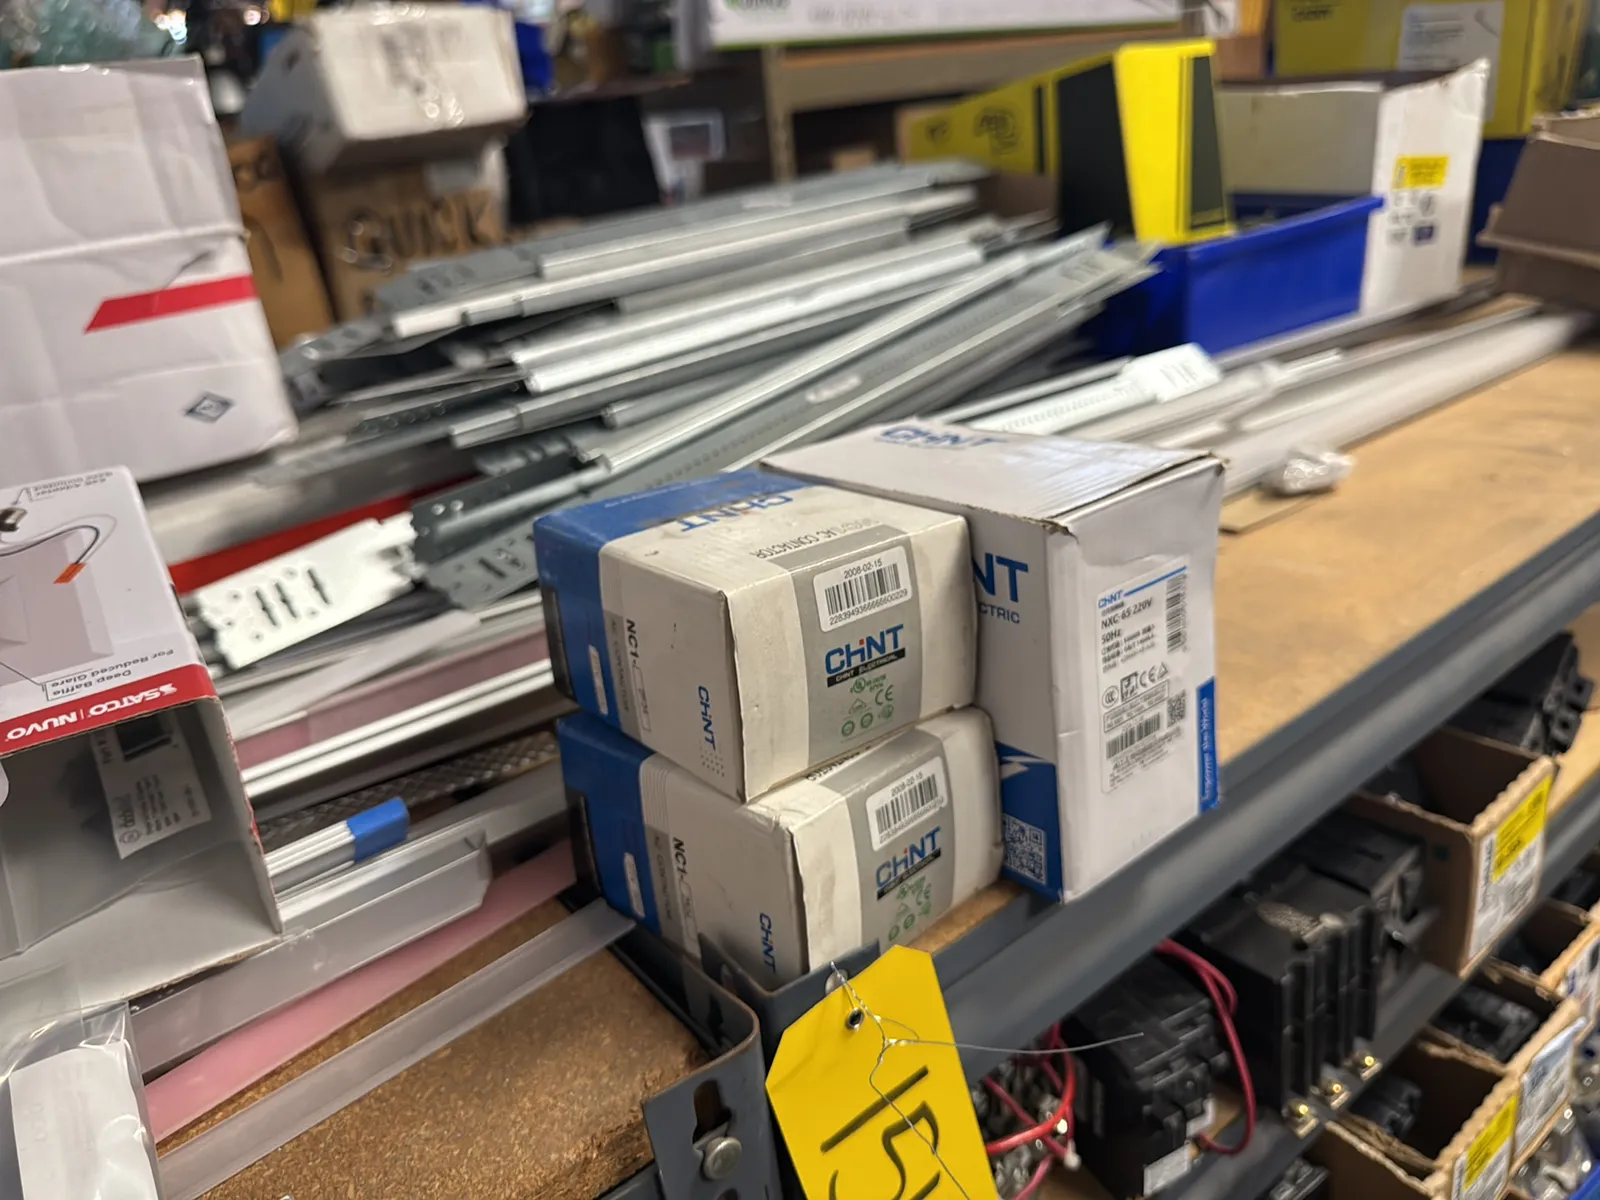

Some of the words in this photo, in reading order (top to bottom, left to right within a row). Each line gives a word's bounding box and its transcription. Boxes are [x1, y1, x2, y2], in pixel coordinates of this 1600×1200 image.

[843, 558, 882, 579] 2008-02-15
[972, 552, 1029, 603] NT
[978, 602, 1021, 624] CTRIC
[1132, 596, 1153, 615] 220V
[151, 649, 174, 662] For
[89, 658, 149, 678] Reduced
[92, 668, 132, 686] Deep
[51, 672, 88, 688] Glare
[53, 679, 91, 697] Baffle
[89, 686, 165, 718] SATCO
[6, 713, 78, 741] NUVO
